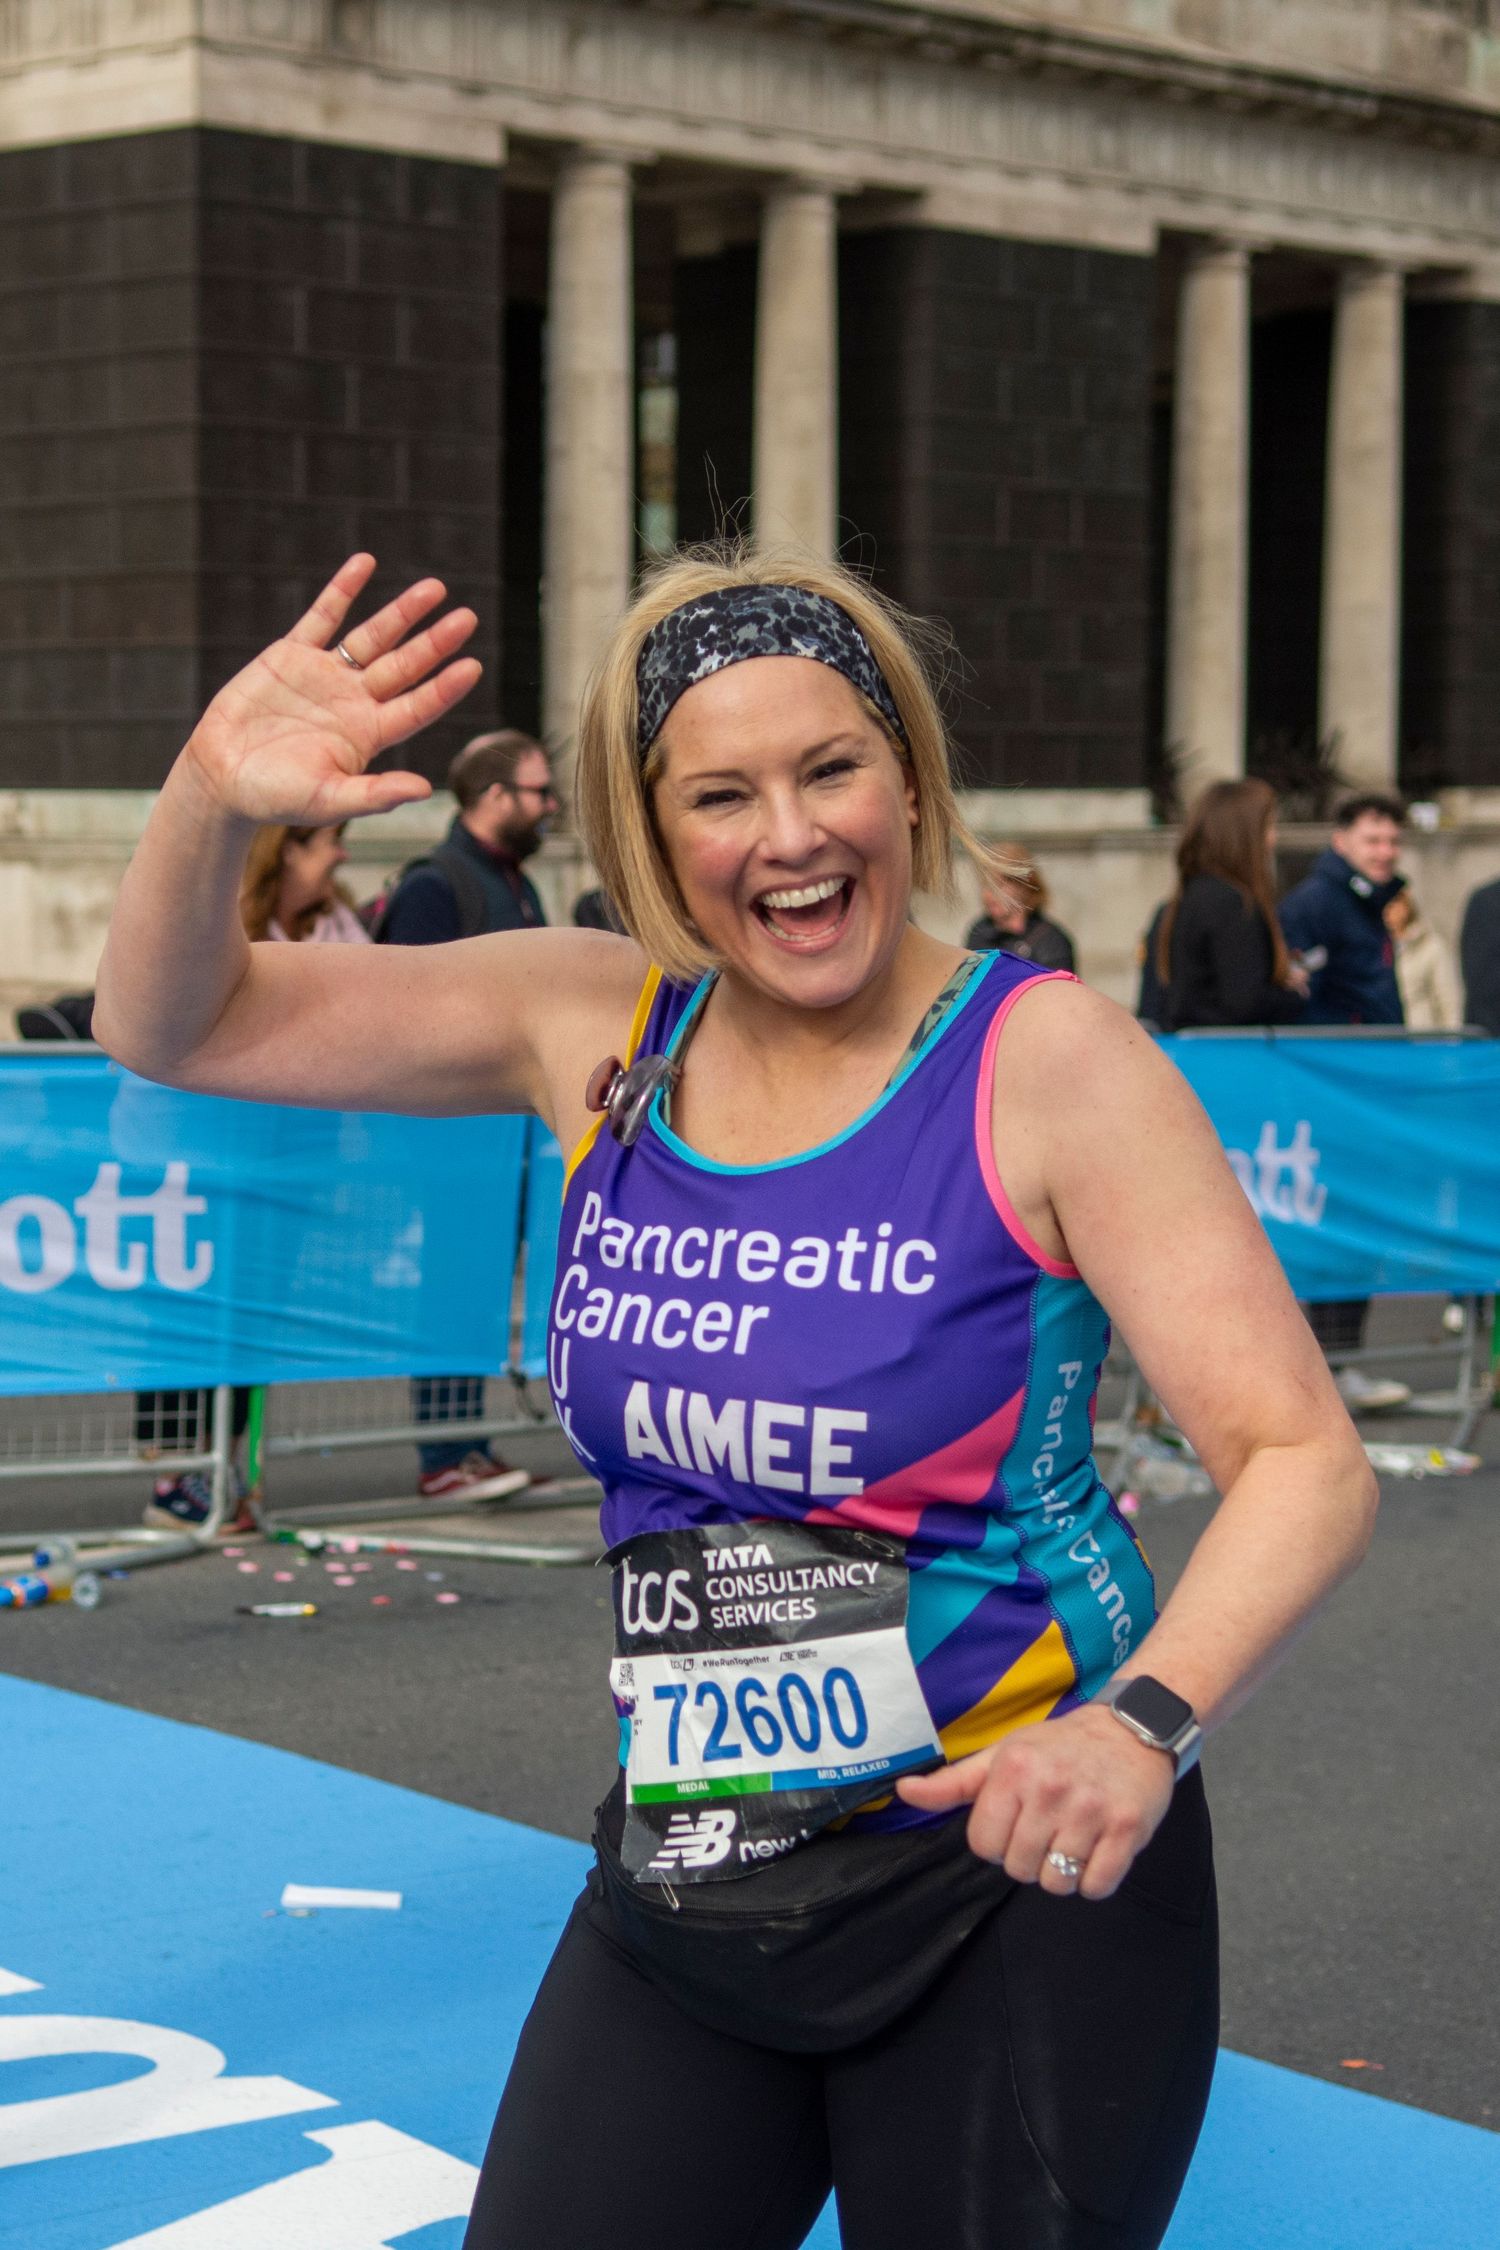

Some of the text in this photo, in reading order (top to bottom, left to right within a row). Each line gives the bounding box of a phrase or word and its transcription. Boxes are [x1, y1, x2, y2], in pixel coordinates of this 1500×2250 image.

[0, 1161, 214, 1294] ott
[572, 1191, 937, 1295] Pancreatic
[554, 1264, 770, 1355] Cancer
[624, 1380, 868, 1497] AIMEE
[622, 1556, 700, 1636] tcs
[703, 1544, 774, 1572] TATA
[705, 1562, 880, 1601] CONSULTANCY
[1068, 1529, 1132, 1667] Cance
[710, 1597, 817, 1629] SERVICES
[653, 1667, 869, 1767] 72600
[677, 1780, 710, 1793] MEDAL
[842, 1759, 890, 1778] RELAXED
